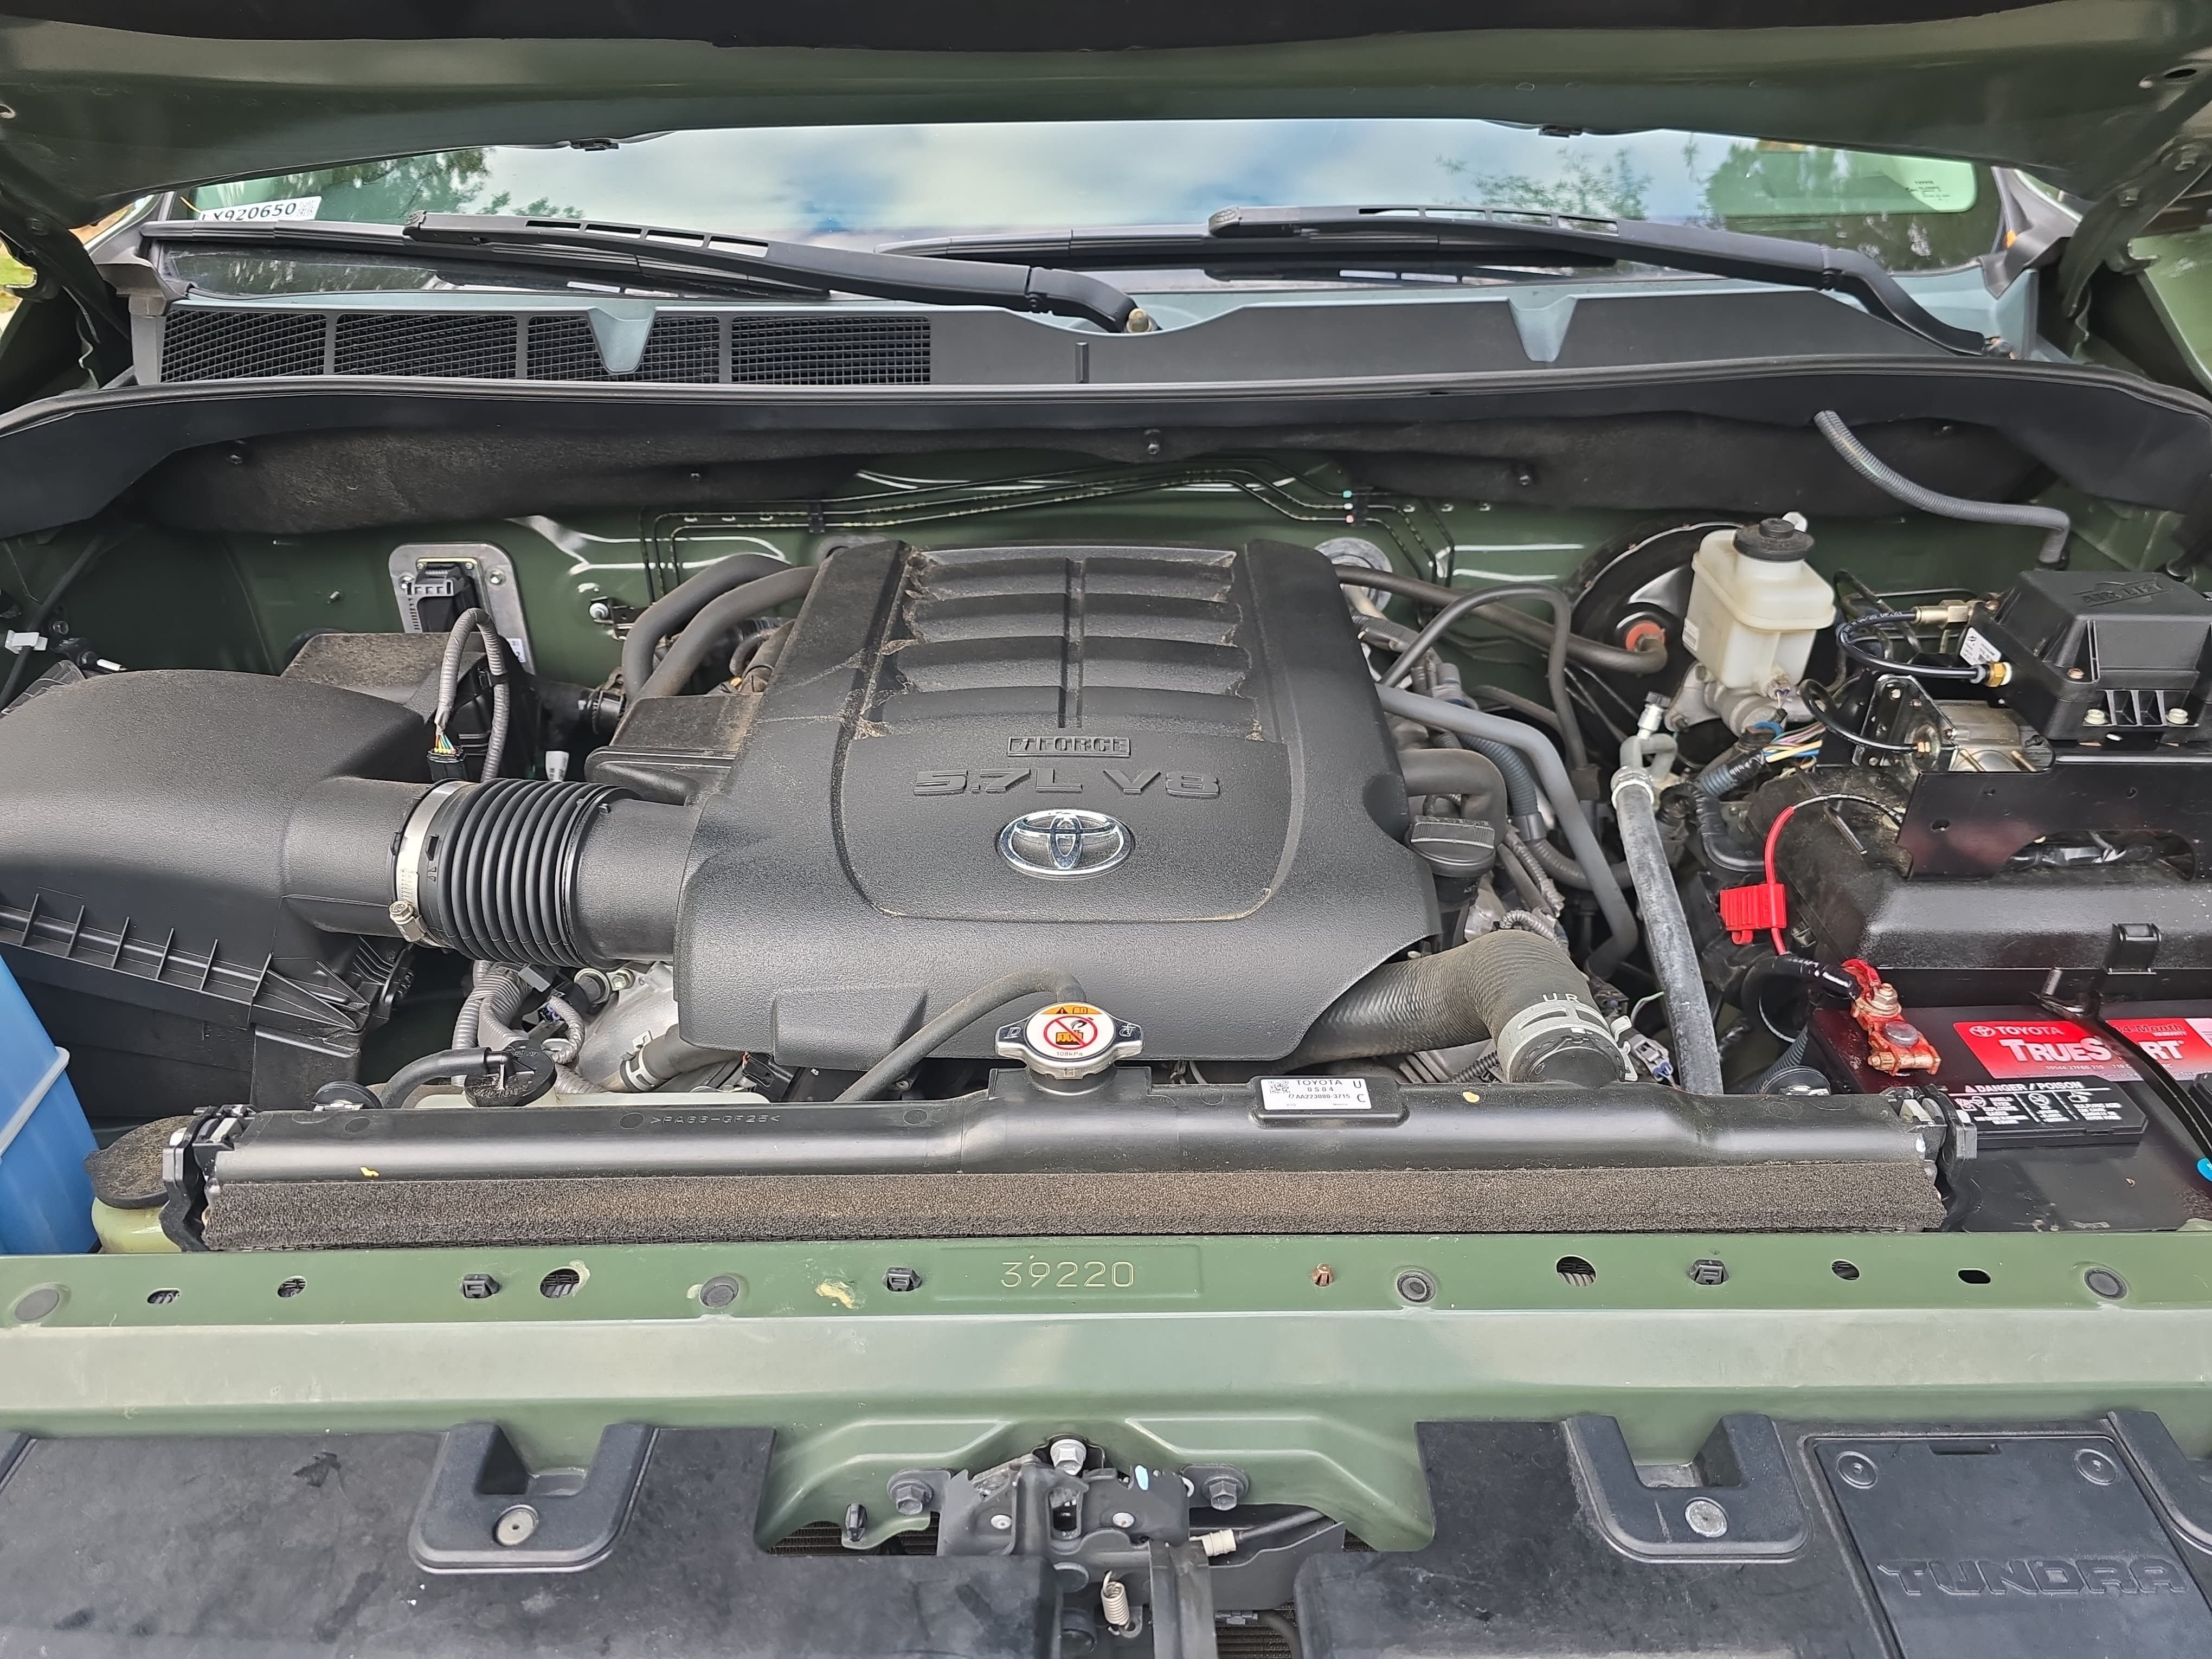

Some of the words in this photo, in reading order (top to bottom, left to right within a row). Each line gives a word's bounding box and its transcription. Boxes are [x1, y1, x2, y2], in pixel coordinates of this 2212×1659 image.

[914, 768, 1083, 795] 5.7L
[1102, 770, 1220, 798] V8
[1995, 1026, 2065, 1035] TOYOTA
[1998, 1037, 2184, 1061] TRUESRT
[1353, 1080, 1361, 1088] U
[1975, 1084, 2028, 1092] DANGER
[2036, 1081, 2086, 1090] POISON
[1357, 1094, 1366, 1102] C
[1000, 1261, 1134, 1288] 39220
[1876, 1559, 2188, 1595] TUNDRA
